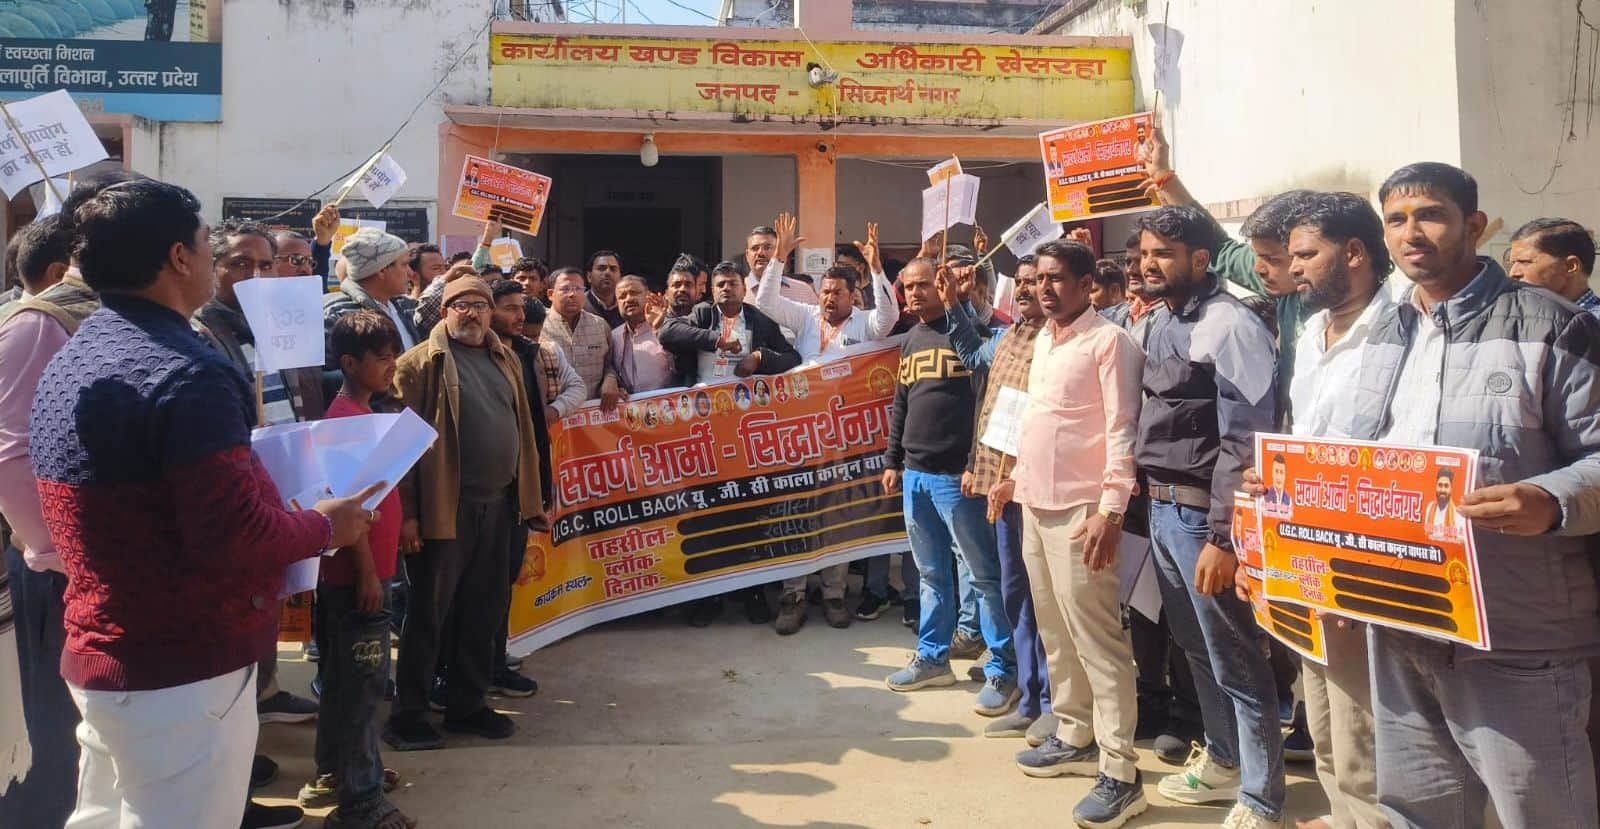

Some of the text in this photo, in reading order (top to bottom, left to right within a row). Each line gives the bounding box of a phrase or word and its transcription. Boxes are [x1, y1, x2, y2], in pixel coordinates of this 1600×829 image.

[5, 46, 52, 61] स्वच्छता
[56, 44, 95, 62] मिशन
[500, 39, 1107, 81] कार्यालय खण्ड विकास अधिकारी खेसरहा
[0, 64, 199, 90] लापूर्ति विभाग, उत्तर प्रदेश
[696, 82, 781, 105] जनपद
[918, 86, 961, 104] नगर
[559, 436, 637, 506] सवर्ण
[639, 420, 718, 486] आर्मी
[738, 394, 896, 469] सिद्धार्थनग
[594, 503, 640, 526] ROLL
[641, 489, 689, 517] BACK
[750, 477, 770, 494] सी
[772, 470, 815, 490] काला
[816, 459, 862, 482] कानून
[1294, 472, 1321, 509] सवर्ण
[1298, 527, 1315, 540] ROLL
[1315, 530, 1335, 544] BACK
